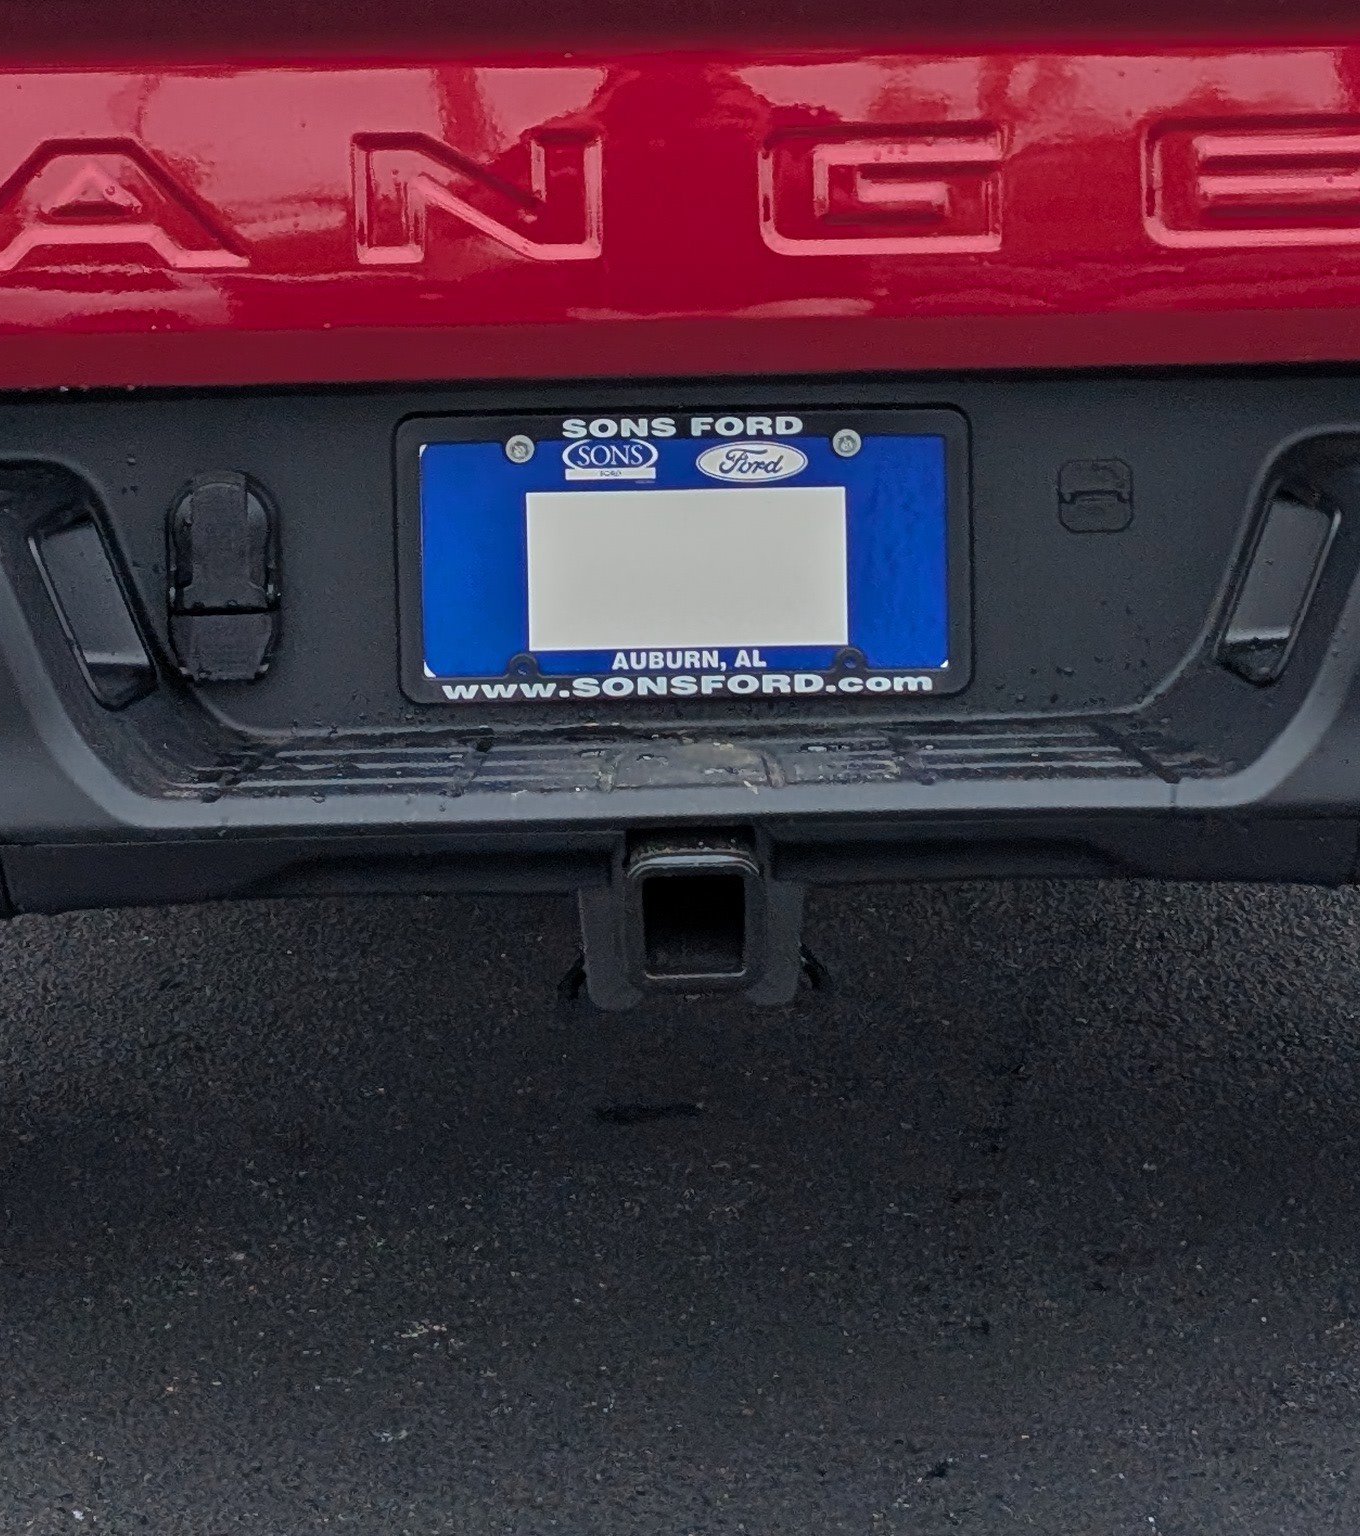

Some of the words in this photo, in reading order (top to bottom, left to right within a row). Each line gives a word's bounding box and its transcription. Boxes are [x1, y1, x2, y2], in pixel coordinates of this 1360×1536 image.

[562, 418, 676, 438] SONS
[691, 416, 803, 436] FORD
[577, 444, 643, 465] SONS
[719, 448, 783, 474] Ford
[612, 650, 727, 671] AUBURN,
[734, 649, 767, 668] AL
[442, 673, 933, 700] www.SONSFORD.com
